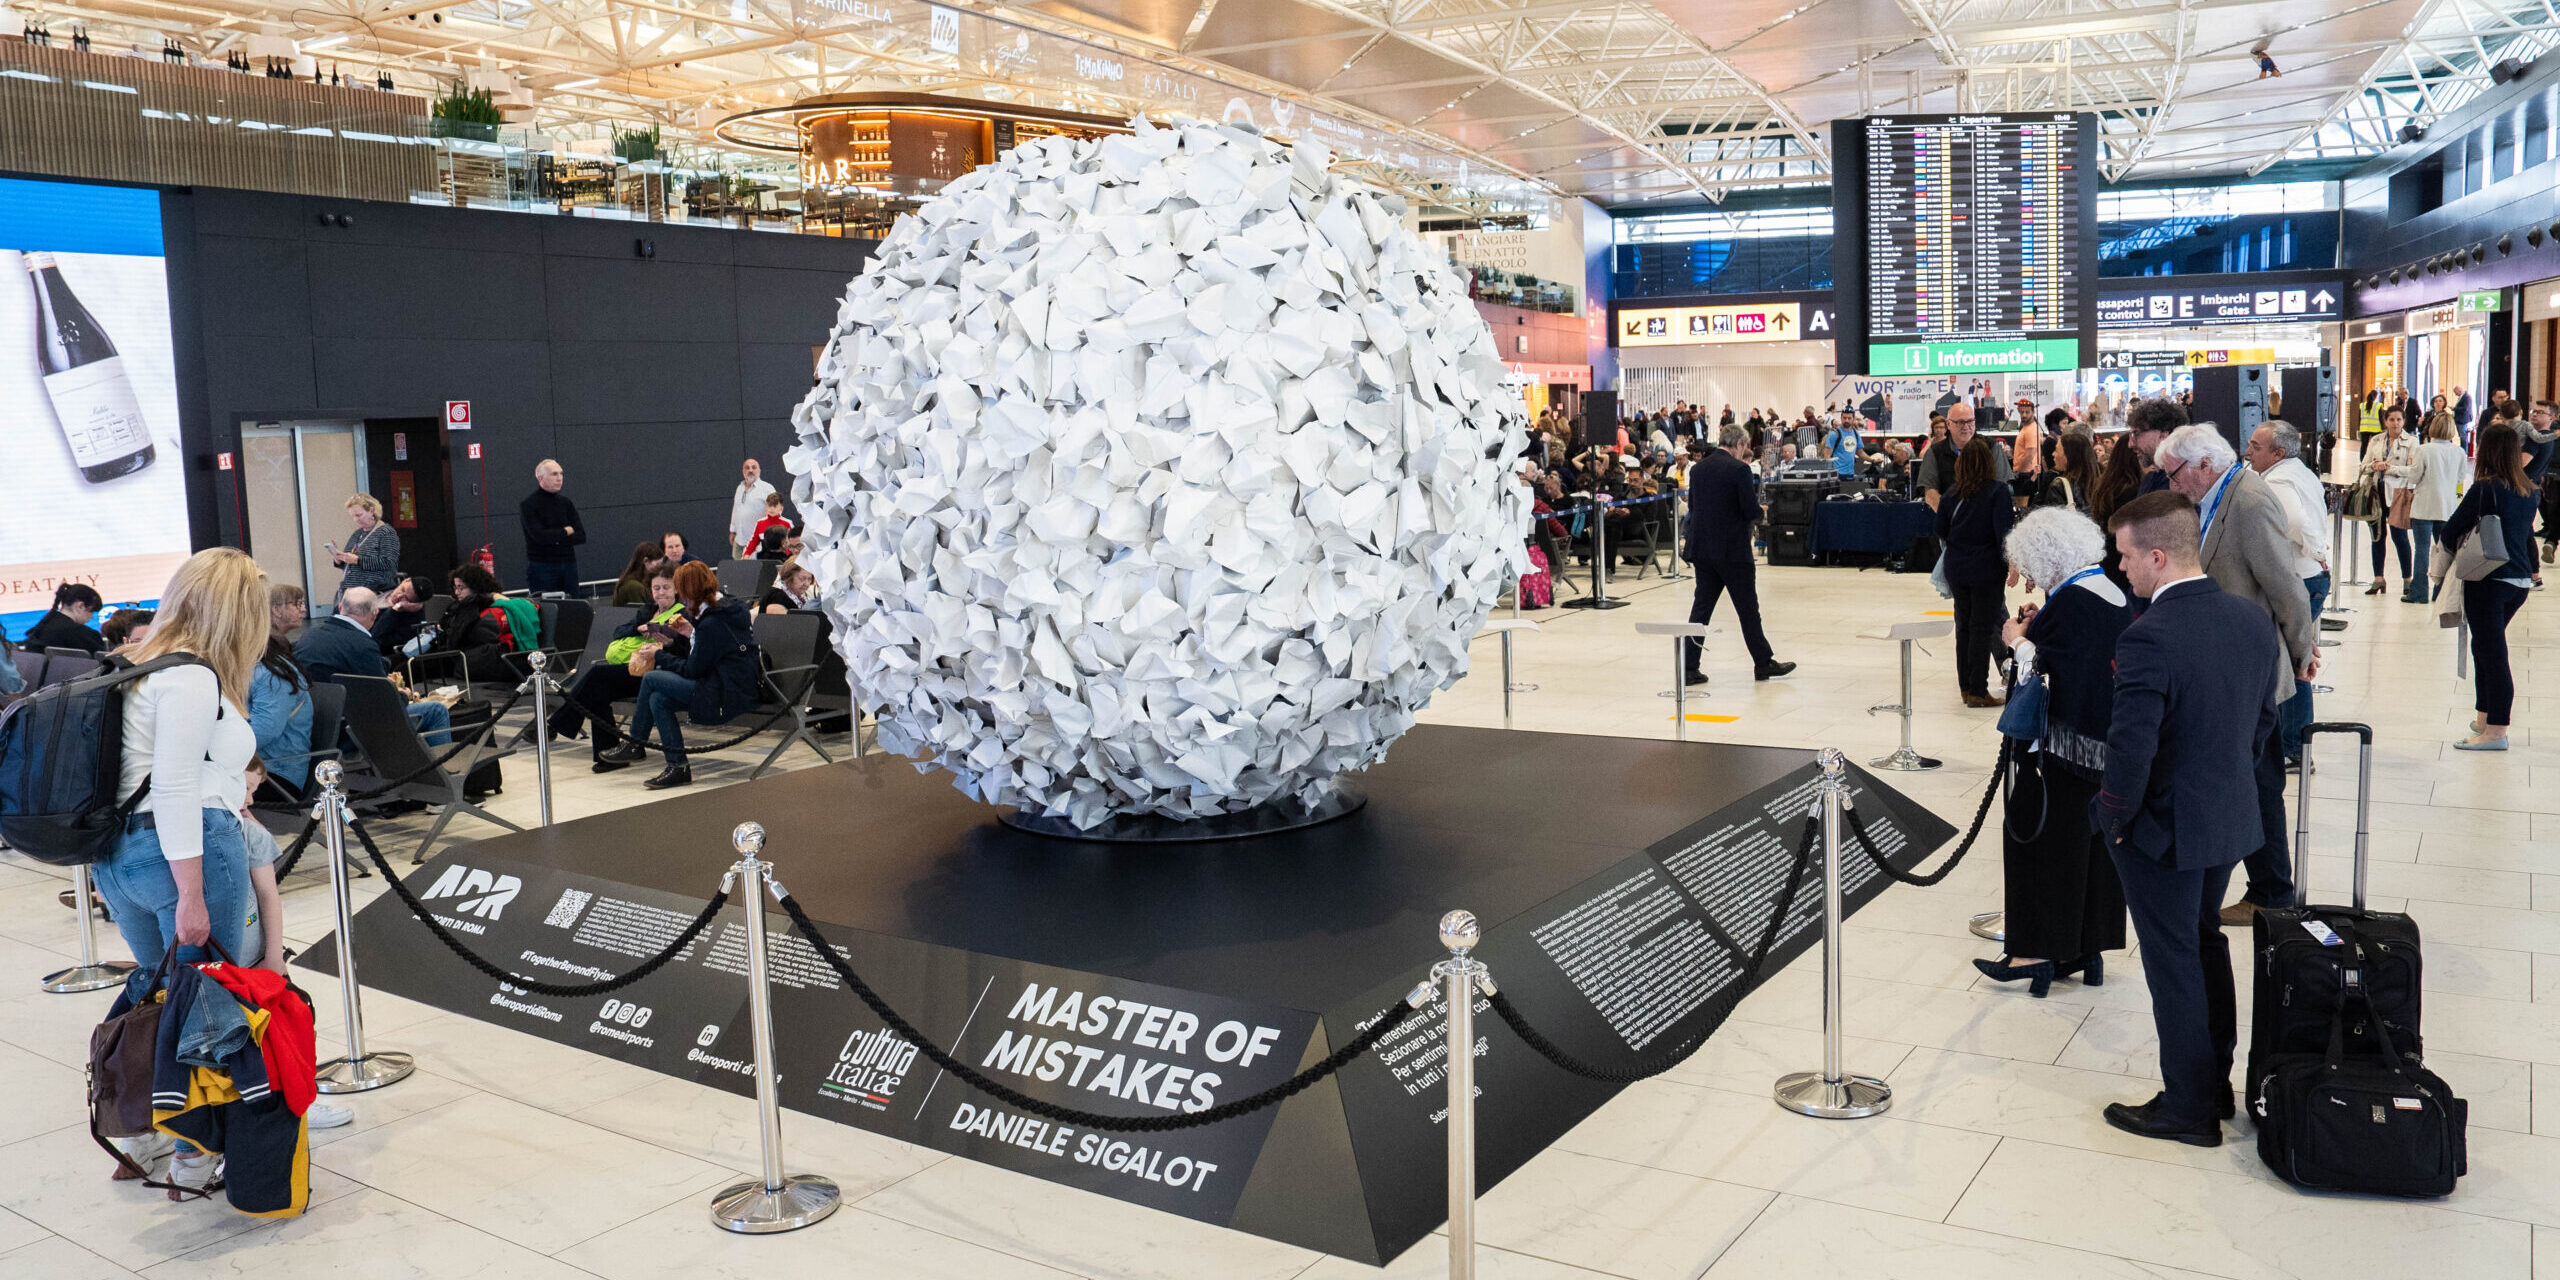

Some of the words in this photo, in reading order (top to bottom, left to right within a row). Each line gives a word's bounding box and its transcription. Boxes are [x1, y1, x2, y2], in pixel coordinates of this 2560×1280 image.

[933, 13, 958, 45] illy
[1074, 53, 1124, 82] TEMAKINHO
[1144, 73, 1200, 101] EATALY
[1960, 115, 2001, 125] Departures
[1464, 235, 1526, 246] MANGIARE
[2105, 309, 2144, 320] control
[2179, 296, 2194, 317] E
[2201, 293, 2250, 306] Imbarchi
[2218, 305, 2250, 316] Gates
[1937, 348, 2044, 367] Information
[461, 922, 486, 935] ROMA
[490, 993, 563, 1022] @AeroportidiRoma
[1427, 1009, 1436, 1019] e
[590, 1021, 653, 1048] @romeairports
[1007, 982, 1200, 1055] MASTER
[1204, 1020, 1280, 1068] OF
[687, 1048, 743, 1072] @Aeroporti
[839, 1027, 919, 1076] cultura
[1380, 1034, 1428, 1066] Sezionare
[1423, 1029, 1437, 1040] la
[1391, 1065, 1412, 1081] Per
[1411, 1040, 1448, 1071] sentirmi
[982, 1030, 1222, 1114] MISTAKES
[1404, 1082, 1420, 1096] In
[1416, 1067, 1440, 1089] tutti
[1434, 1065, 1445, 1077] i
[949, 1102, 1074, 1157] DANIELE
[1074, 1132, 1218, 1193] SIGALOT
